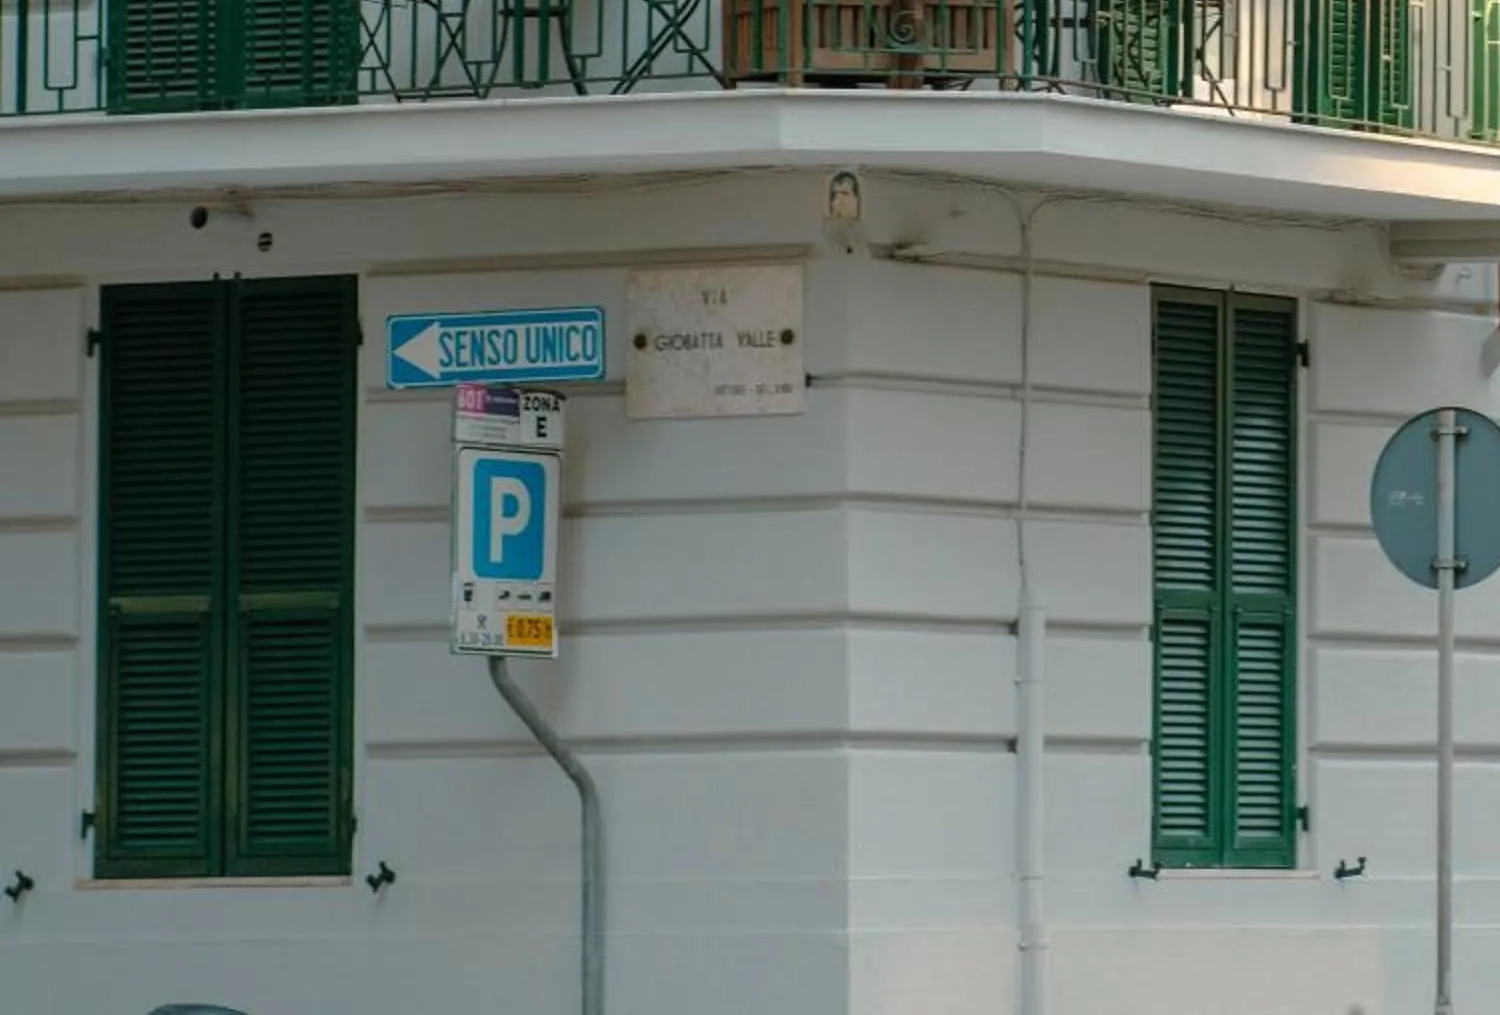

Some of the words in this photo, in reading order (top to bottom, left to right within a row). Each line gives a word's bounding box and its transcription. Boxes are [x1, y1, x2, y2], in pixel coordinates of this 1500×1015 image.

[701, 287, 728, 306] VIA
[439, 328, 518, 368] SENSO
[525, 324, 597, 364] UNICO
[737, 330, 777, 348] VALLE
[523, 395, 561, 412] ZONA
[536, 416, 547, 438] E
[489, 476, 532, 563] P
